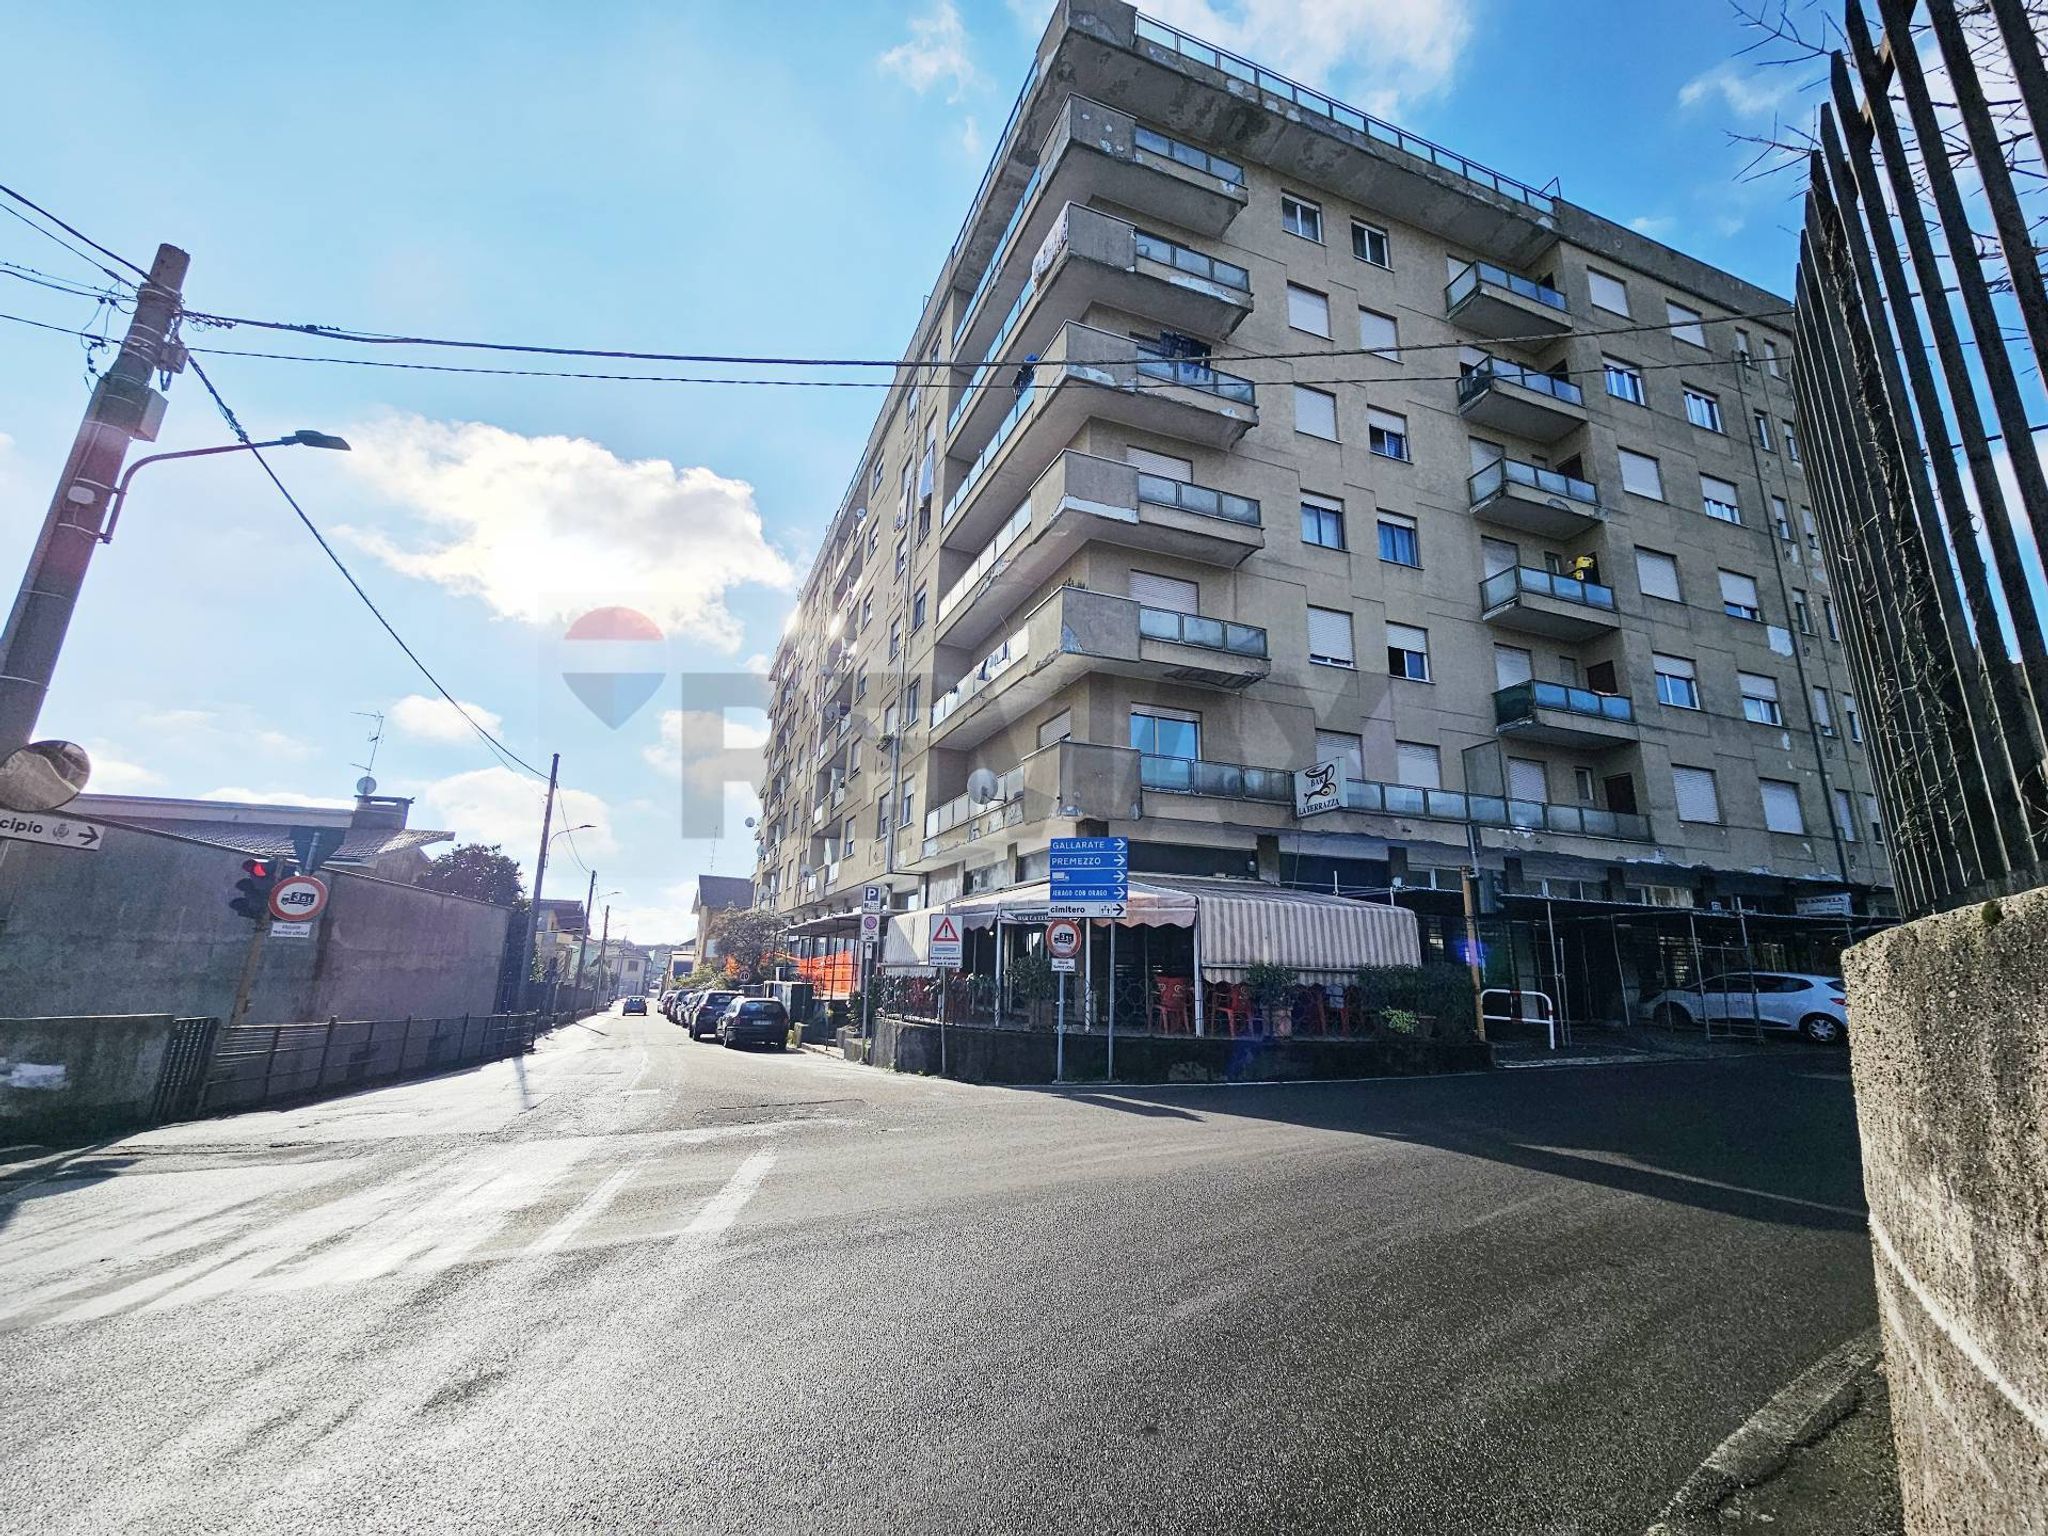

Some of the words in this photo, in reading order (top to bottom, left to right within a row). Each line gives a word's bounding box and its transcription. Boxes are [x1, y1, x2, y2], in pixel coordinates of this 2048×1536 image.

[1311, 776, 1324, 787] BAR
[1052, 841, 1105, 850] GALLARATE
[1051, 857, 1101, 866] PREMEZZO
[867, 888, 877, 900] P
[1050, 905, 1086, 913] cimitero
